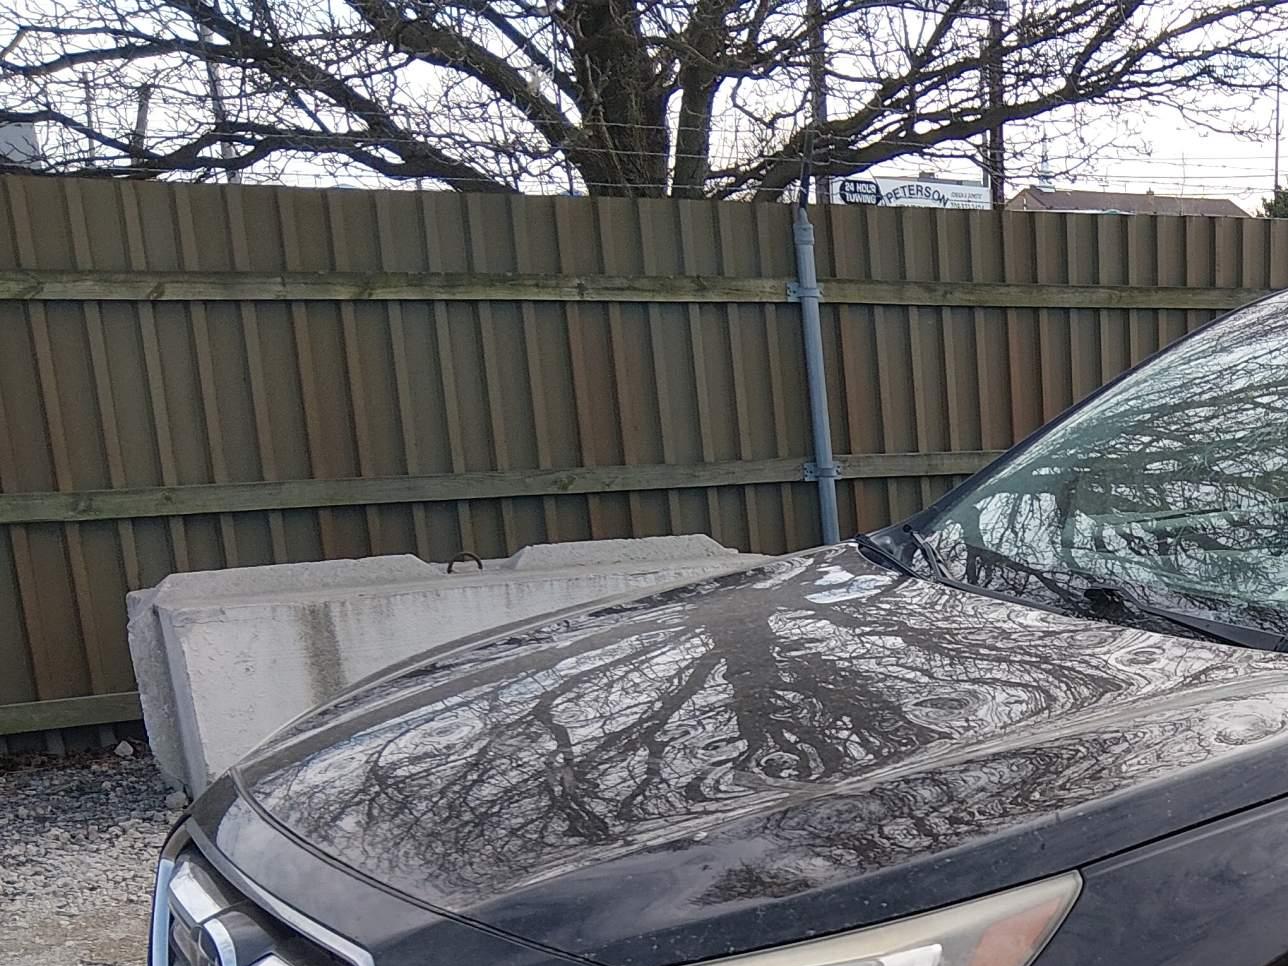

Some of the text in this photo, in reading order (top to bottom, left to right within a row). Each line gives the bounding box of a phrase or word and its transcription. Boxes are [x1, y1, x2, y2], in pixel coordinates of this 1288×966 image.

[845, 182, 855, 192] 24
[845, 193, 876, 204] TOWING
[887, 184, 949, 208] PETERSON
